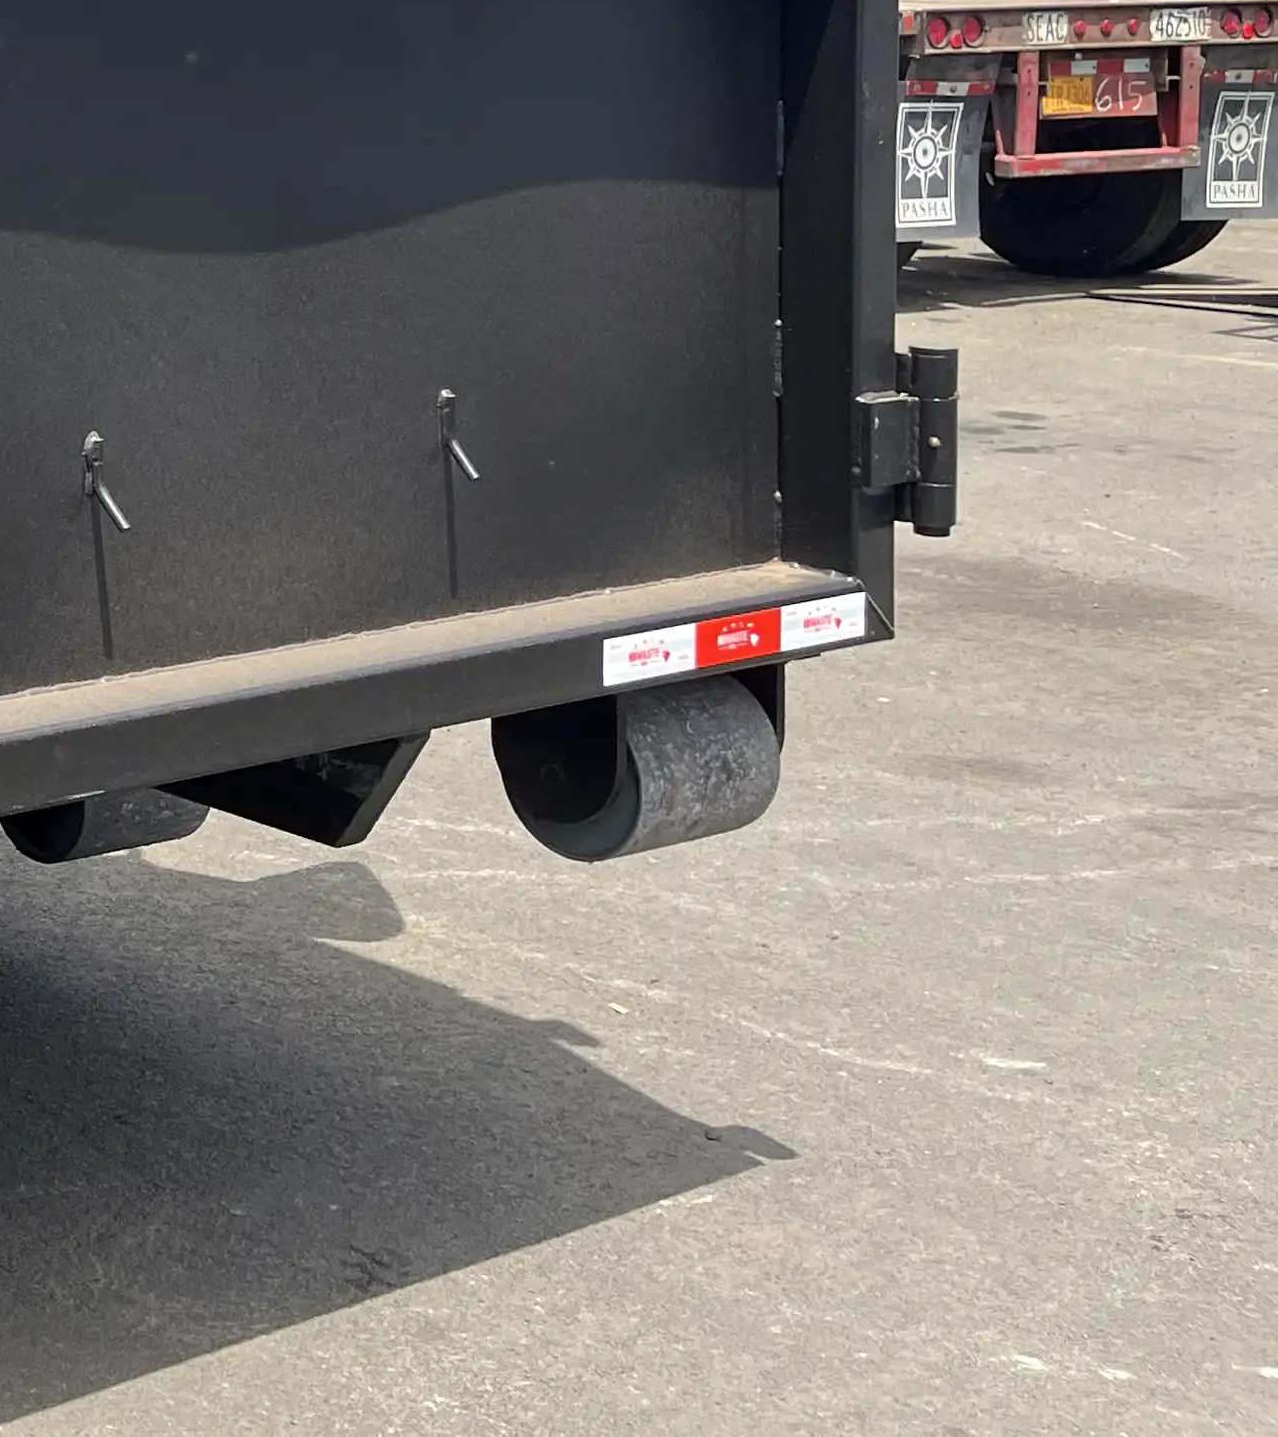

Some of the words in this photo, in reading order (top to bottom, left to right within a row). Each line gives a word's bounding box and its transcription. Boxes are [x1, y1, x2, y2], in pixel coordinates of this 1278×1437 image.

[1095, 76, 1146, 111] 615
[1213, 184, 1257, 200] PASHA
[902, 201, 949, 219] PASHA
